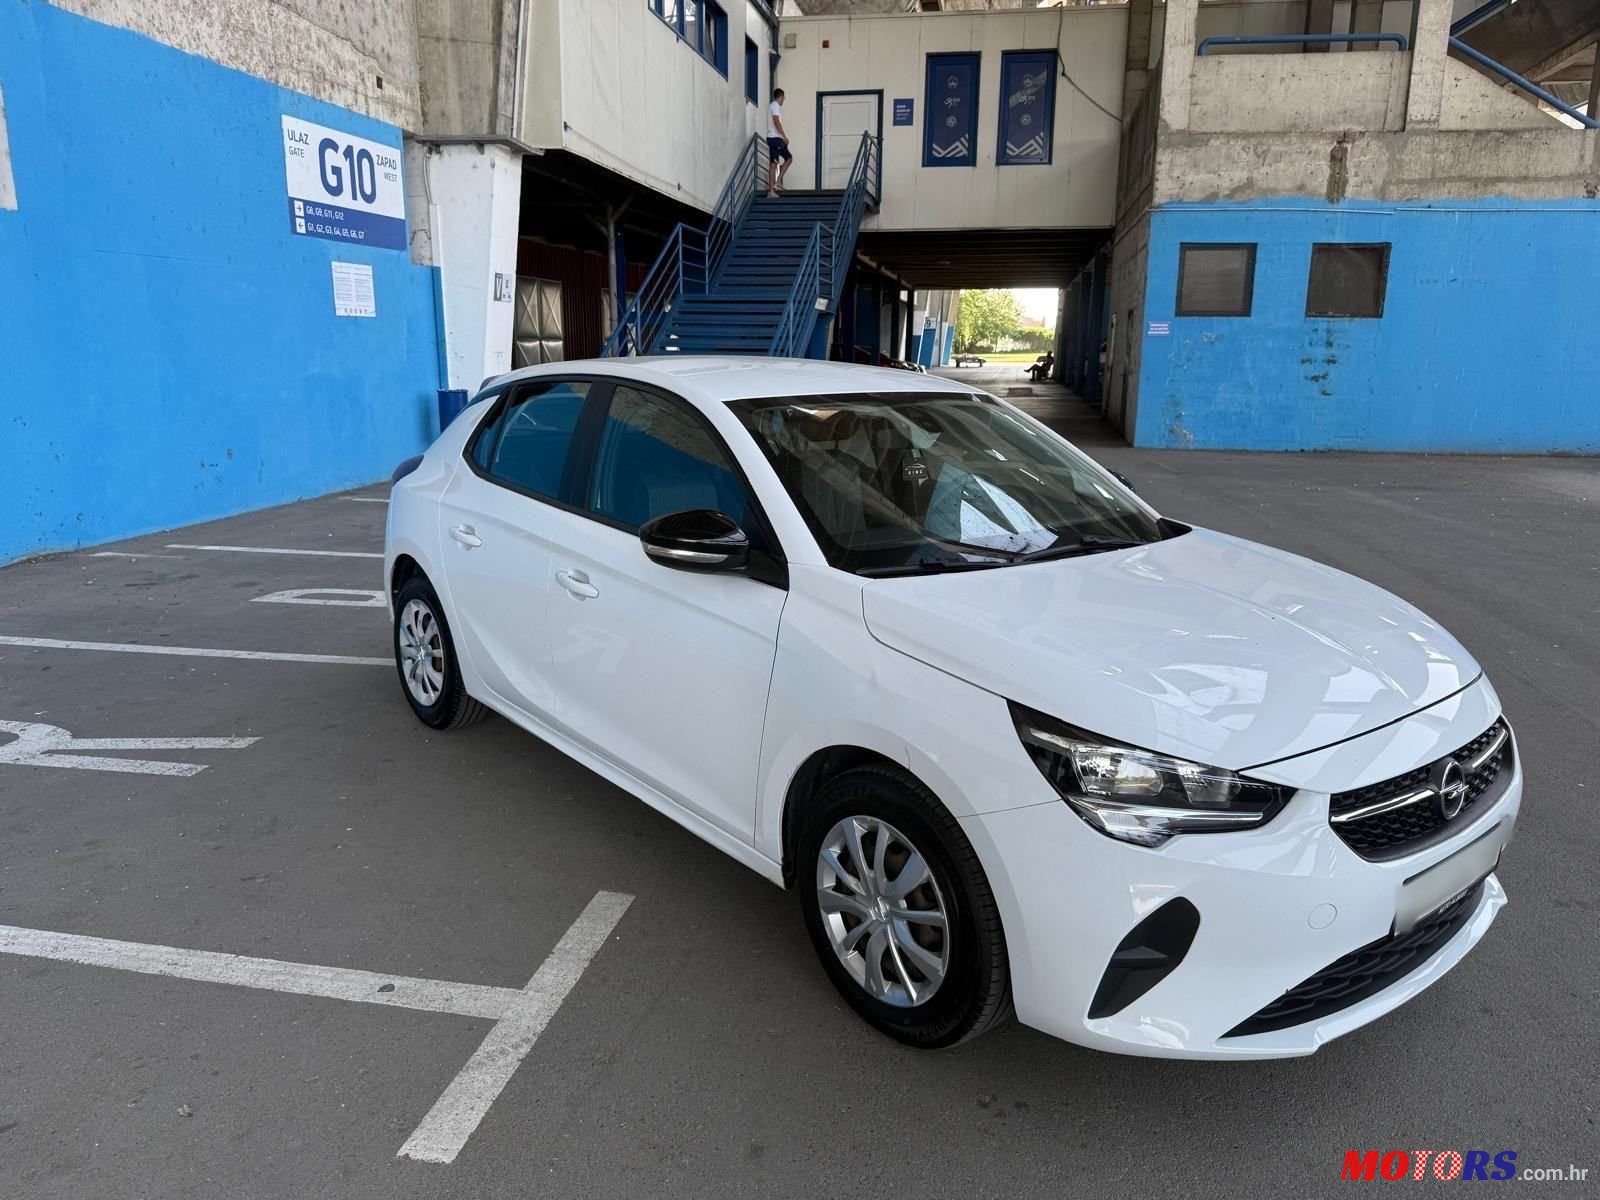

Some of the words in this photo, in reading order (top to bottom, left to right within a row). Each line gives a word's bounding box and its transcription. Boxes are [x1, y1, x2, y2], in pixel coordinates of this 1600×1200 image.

[287, 128, 310, 145] ULAZ
[289, 146, 305, 158] GATE
[376, 154, 397, 170] ZAPAD
[318, 137, 377, 204] G10
[384, 171, 398, 182] WEST
